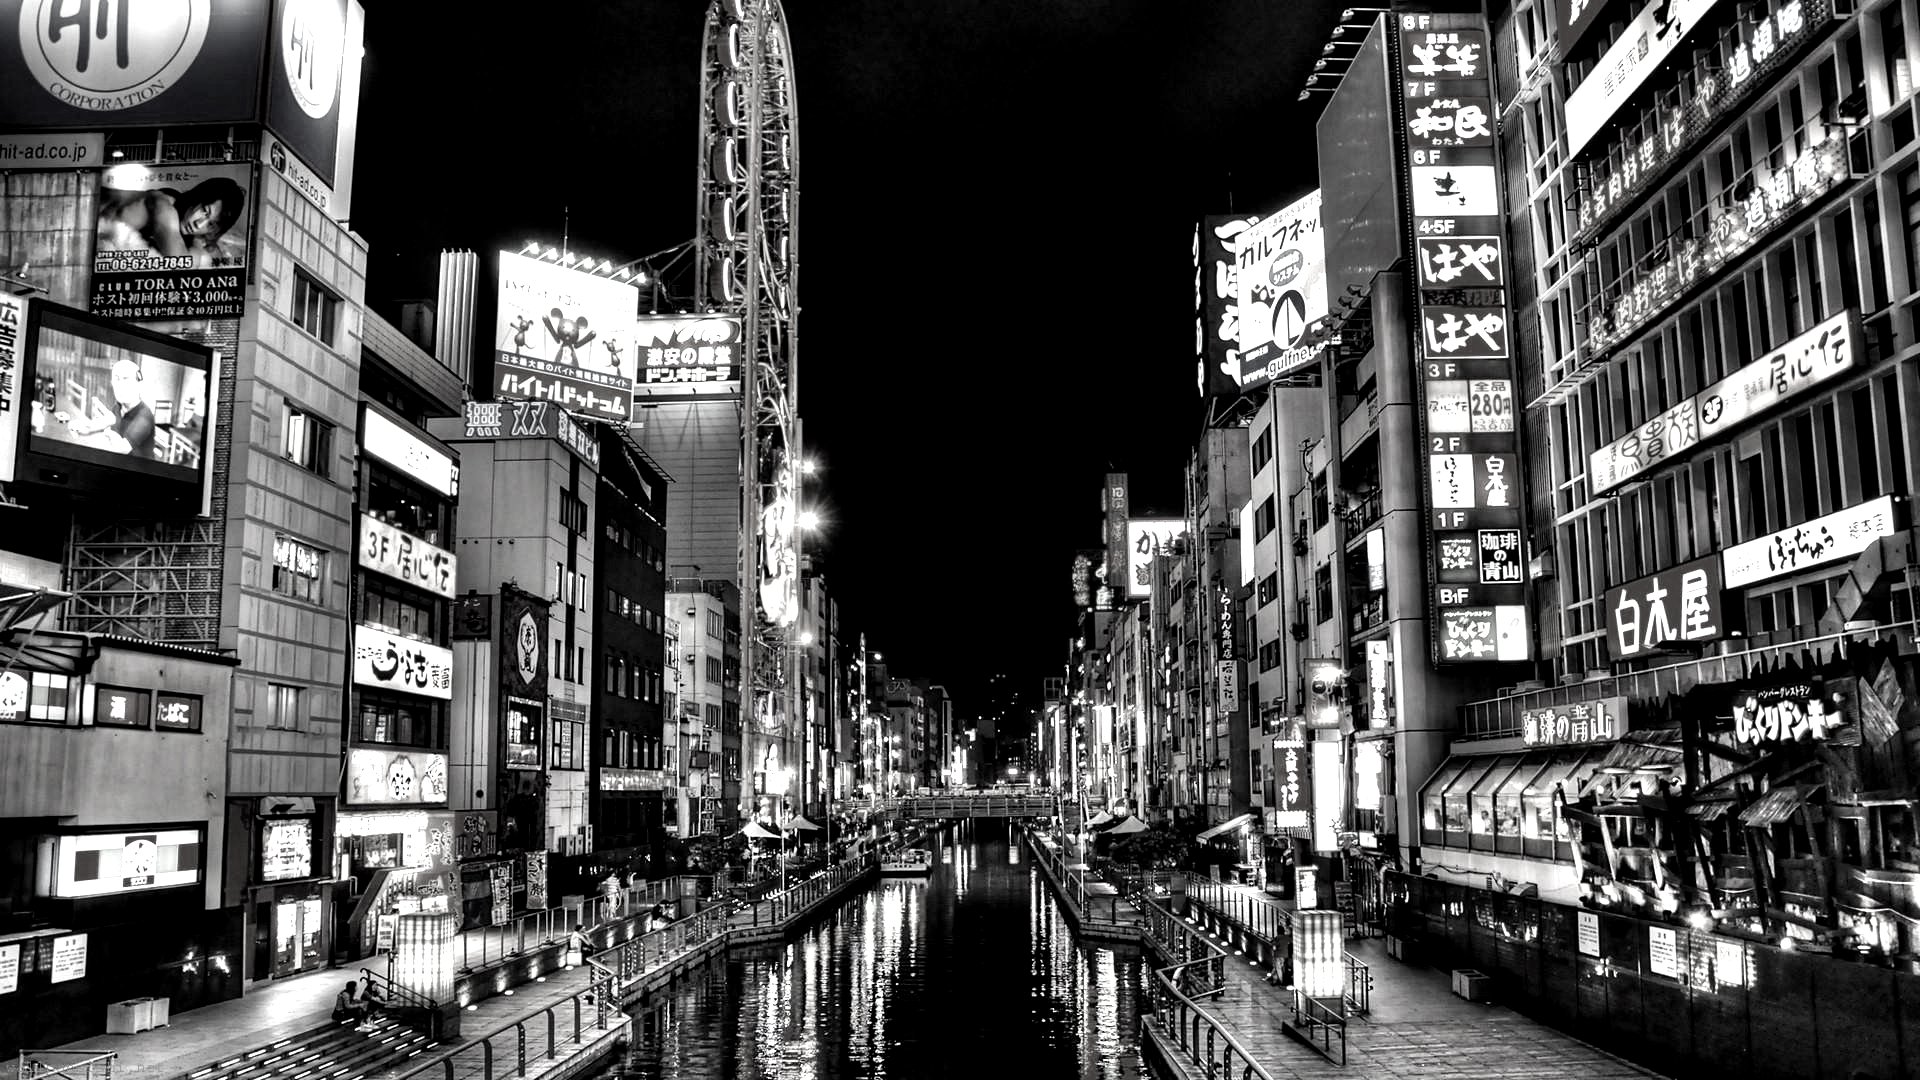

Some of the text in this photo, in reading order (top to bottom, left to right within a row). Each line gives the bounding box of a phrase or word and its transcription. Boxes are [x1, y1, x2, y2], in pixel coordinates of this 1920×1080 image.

[1402, 15, 1430, 30] 8F
[48, 79, 167, 111] CORPORATION
[1407, 82, 1436, 97] 7F
[1408, 105, 1491, 139] 和民
[1431, 137, 1465, 146] わたみ
[1412, 150, 1441, 165] 6F
[97, 256, 193, 271] TEL 06-6214-7845
[1421, 243, 1498, 283] はや
[134, 278, 176, 291] TORA
[179, 276, 203, 289] NO
[1425, 312, 1504, 354] はや
[1428, 363, 1457, 378] 3F
[1770, 324, 1846, 395] 居心伝
[500, 373, 626, 415] バイトルドットコム
[1473, 381, 1507, 393] 全品
[1471, 393, 1512, 417] 280円
[1704, 396, 1721, 423] 3F
[1432, 437, 1461, 452] 2F
[1484, 455, 1510, 507] 白木屋
[1437, 512, 1465, 527] 1F
[367, 531, 390, 563] 3F
[1481, 532, 1518, 551] 珈琲
[397, 533, 450, 592] 居心伝
[1493, 549, 1508, 562] の
[1483, 561, 1520, 581] 青山
[1440, 588, 1469, 604] B1F
[1614, 568, 1717, 656] 白木屋
[1446, 616, 1492, 641] びっくり
[1444, 638, 1496, 658] ドンキー
[371, 641, 428, 689] うなぎ
[157, 701, 190, 724] たばこ
[1522, 701, 1613, 746] 珈琲の青山
[1732, 695, 1843, 747] びっくりドンキー
